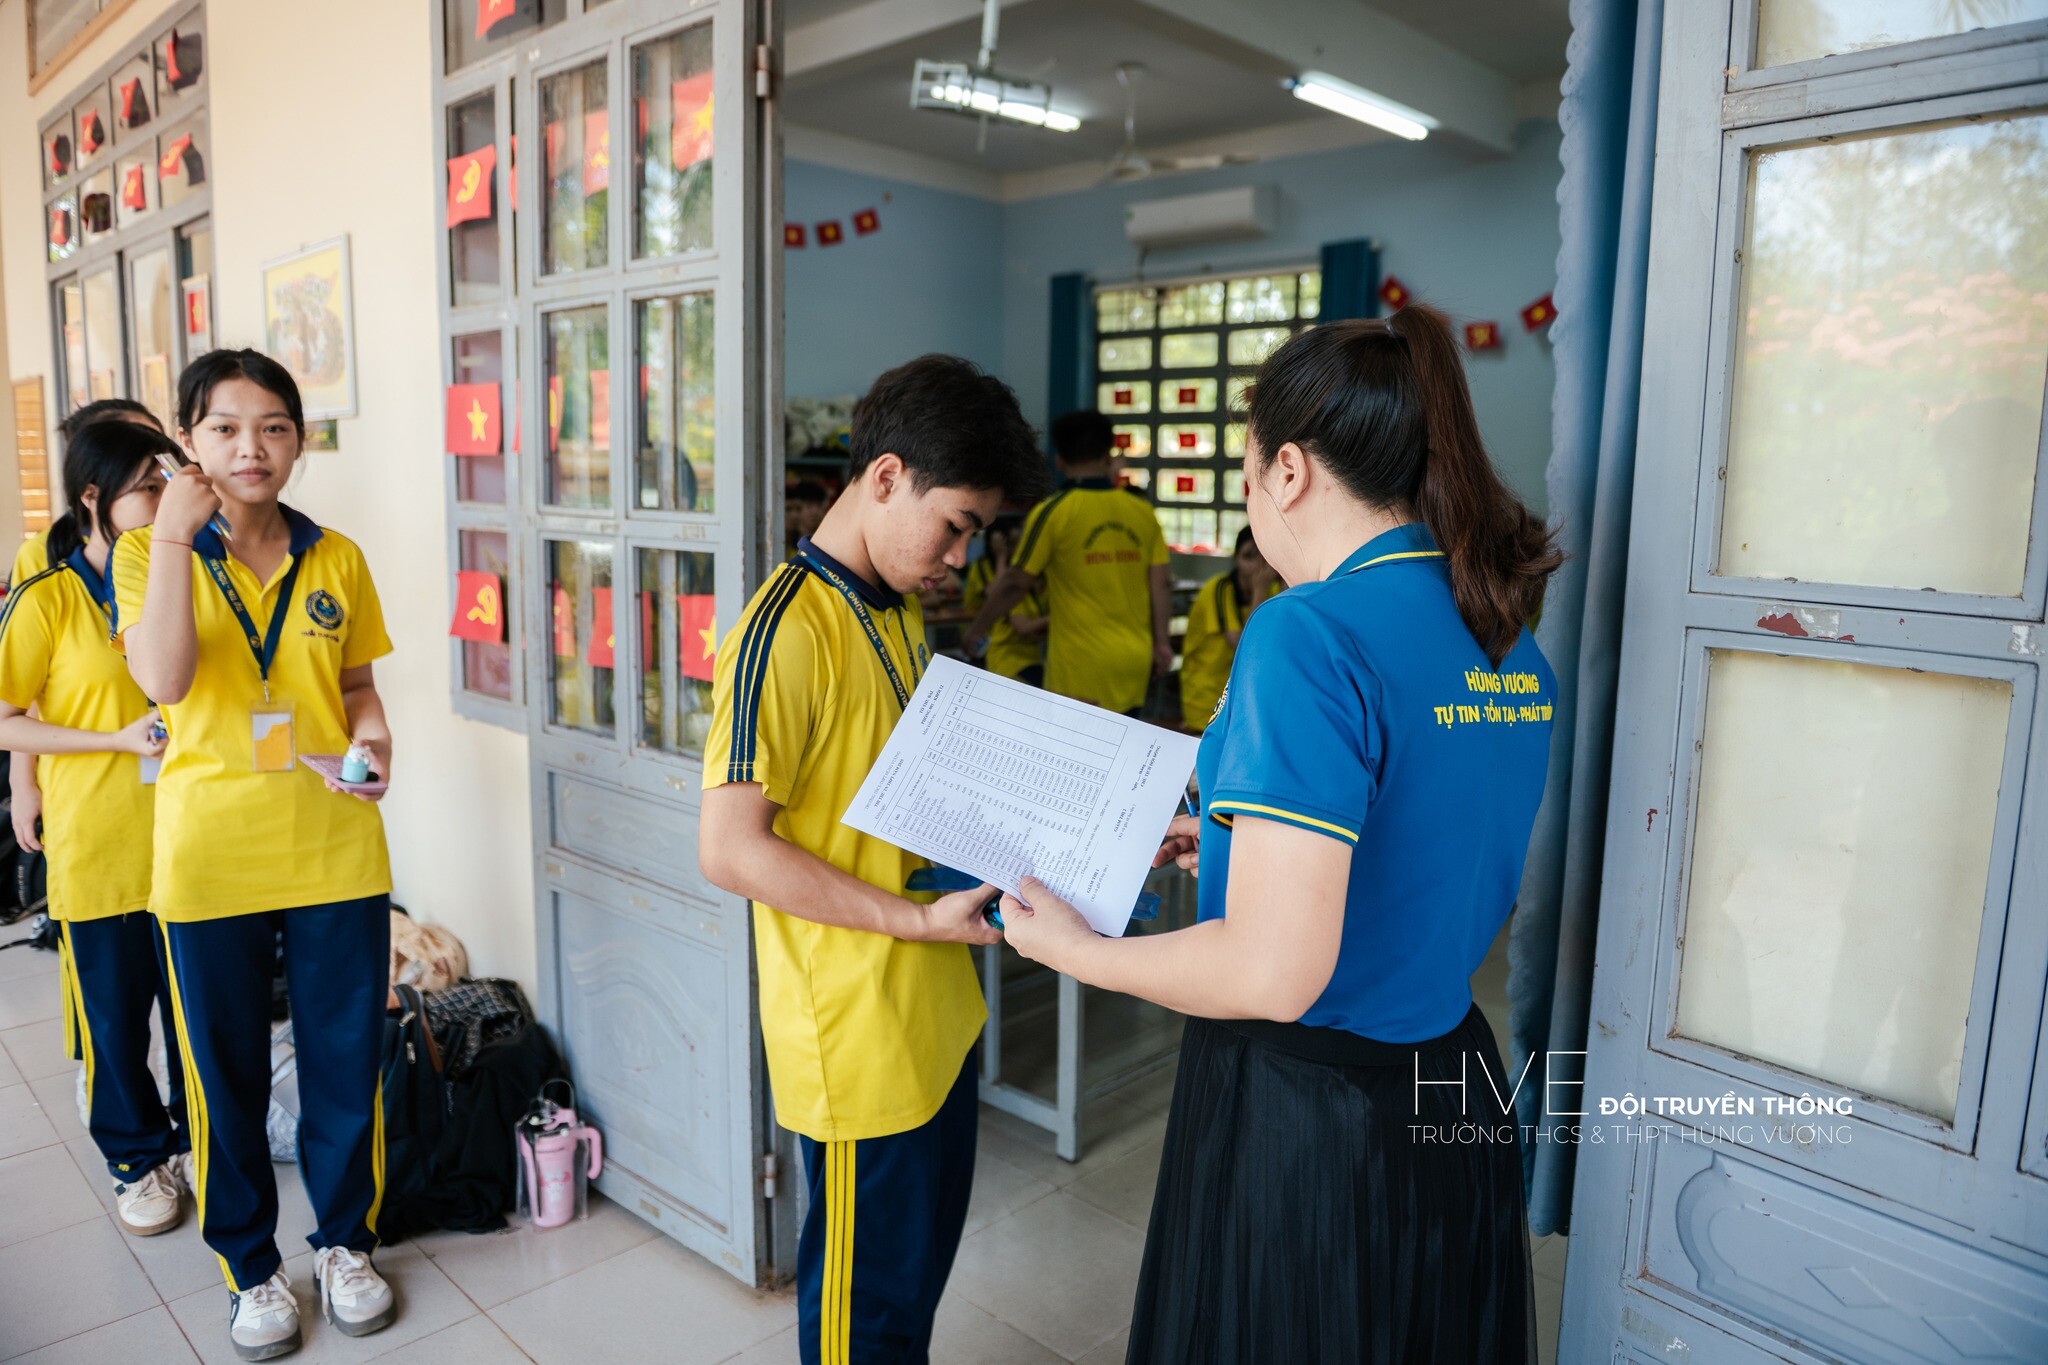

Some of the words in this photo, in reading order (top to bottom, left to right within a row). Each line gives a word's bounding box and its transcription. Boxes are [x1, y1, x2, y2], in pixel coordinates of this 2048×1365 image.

[847, 591, 867, 618] HÙNG
[864, 617, 879, 643] THPT
[1464, 665, 1501, 693] HÙNG
[1501, 671, 1539, 694] VƯƠNG
[1434, 703, 1454, 729] TỰ
[1456, 705, 1480, 723] TIN
